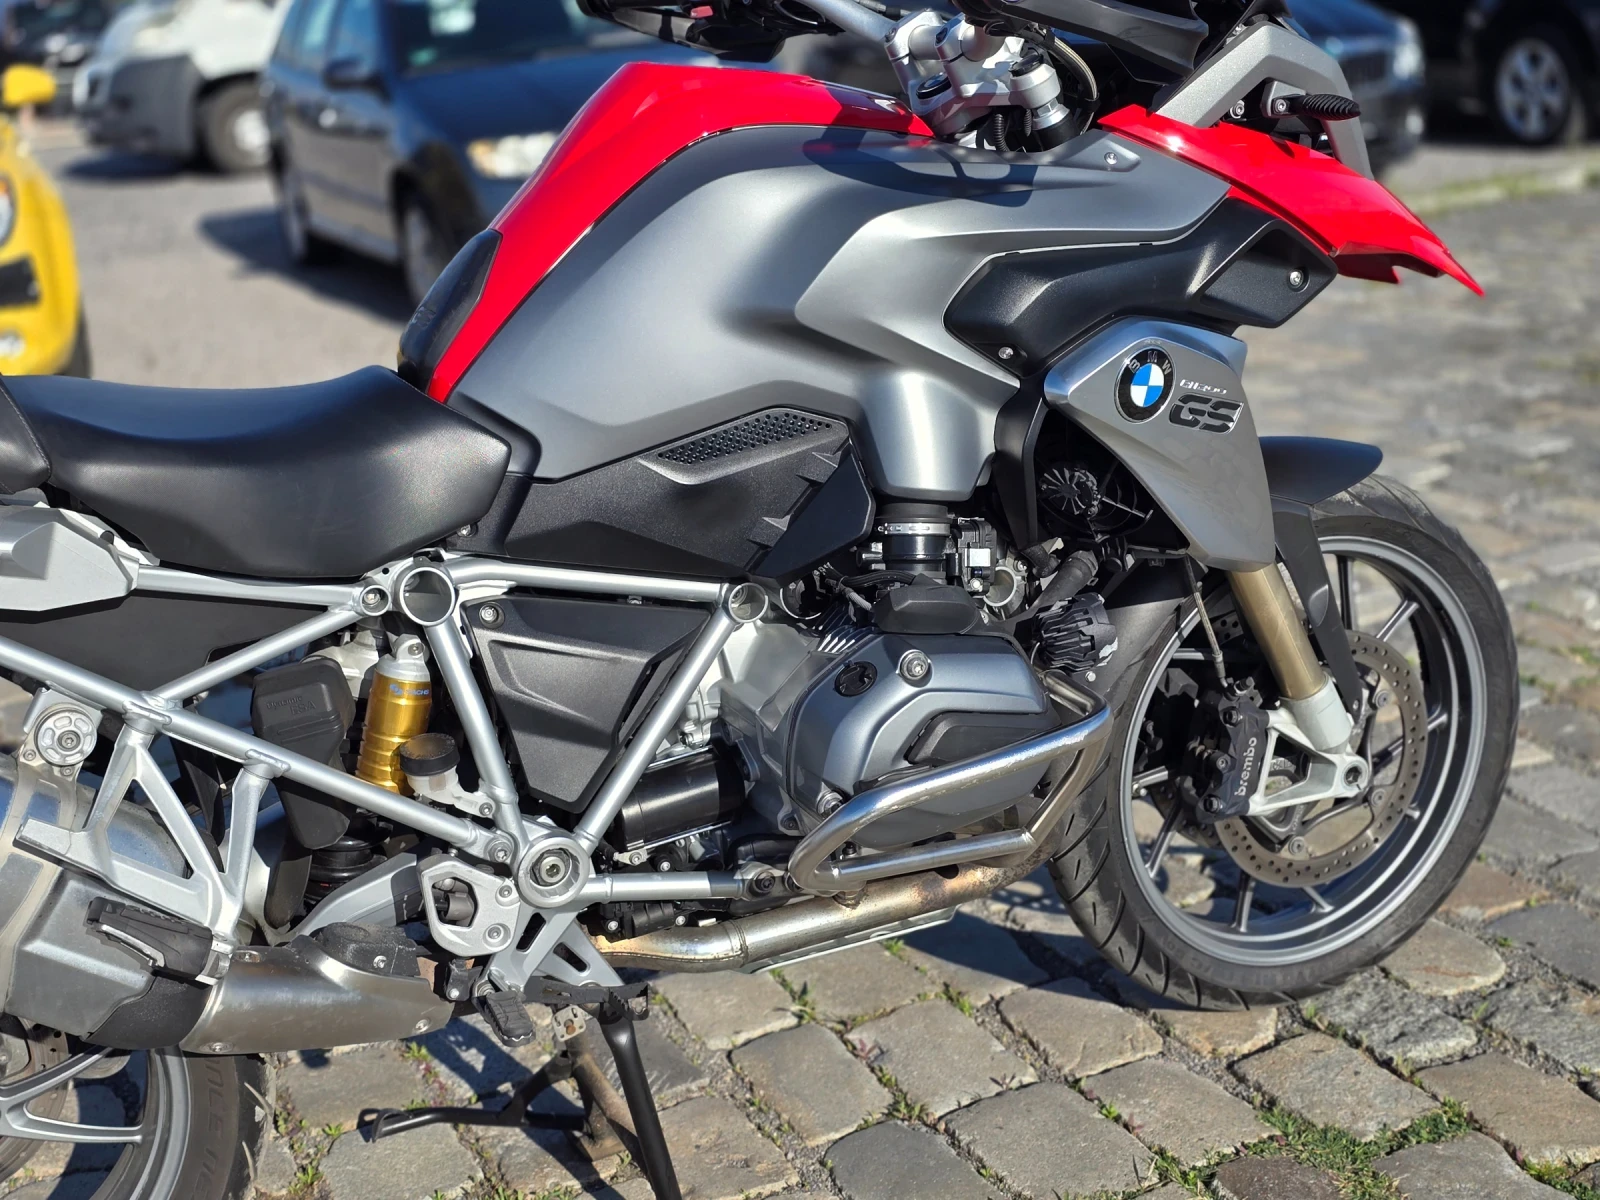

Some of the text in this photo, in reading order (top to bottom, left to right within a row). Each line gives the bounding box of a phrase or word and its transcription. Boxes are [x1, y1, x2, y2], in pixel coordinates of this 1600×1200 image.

[1128, 350, 1172, 375] BMW
[1168, 393, 1244, 434] GS
[1234, 736, 1258, 797] brembo
